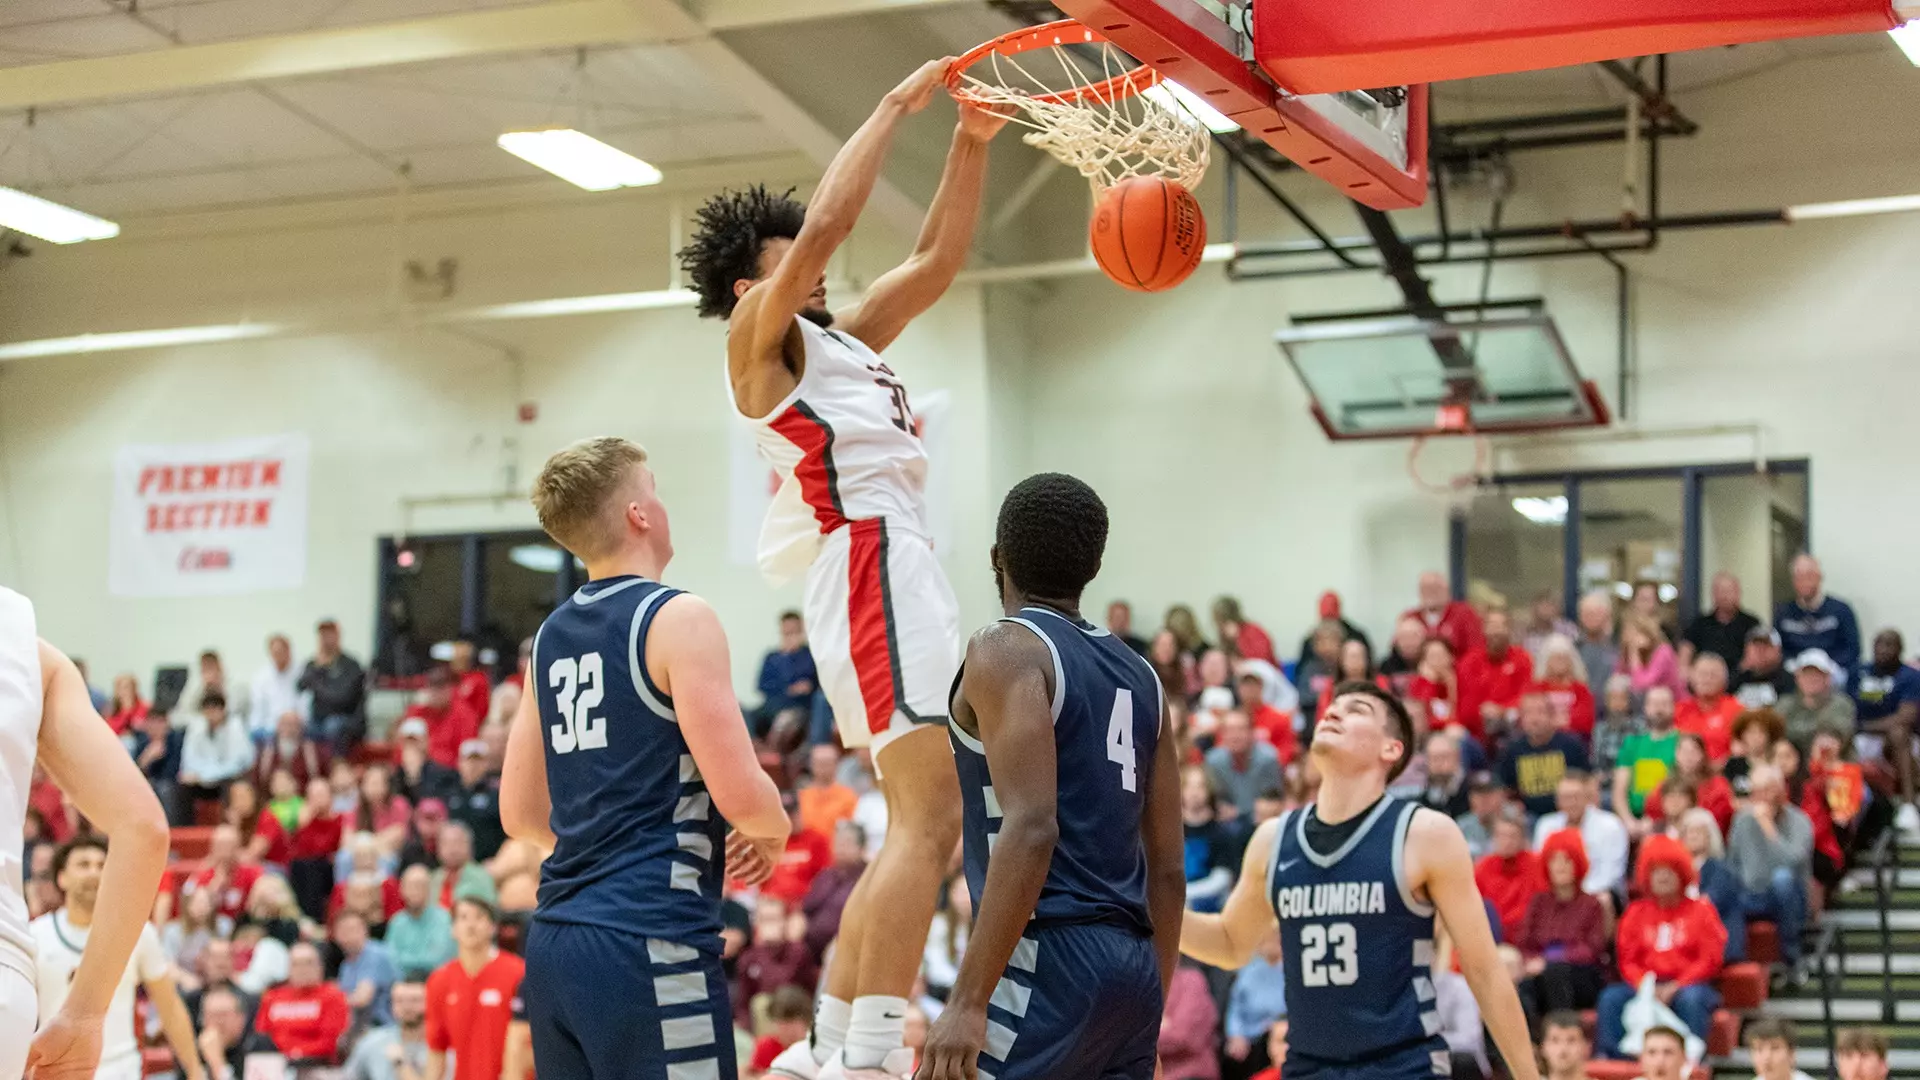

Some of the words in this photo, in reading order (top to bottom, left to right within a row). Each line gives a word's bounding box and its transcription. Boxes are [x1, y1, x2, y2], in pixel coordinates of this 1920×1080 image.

[137, 460, 282, 497] PREMIUM
[146, 500, 272, 534] SECTION
[549, 652, 608, 755] 32
[1106, 687, 1137, 793] 4
[1278, 881, 1386, 919] COLUMBIA
[1301, 922, 1359, 987] 23
